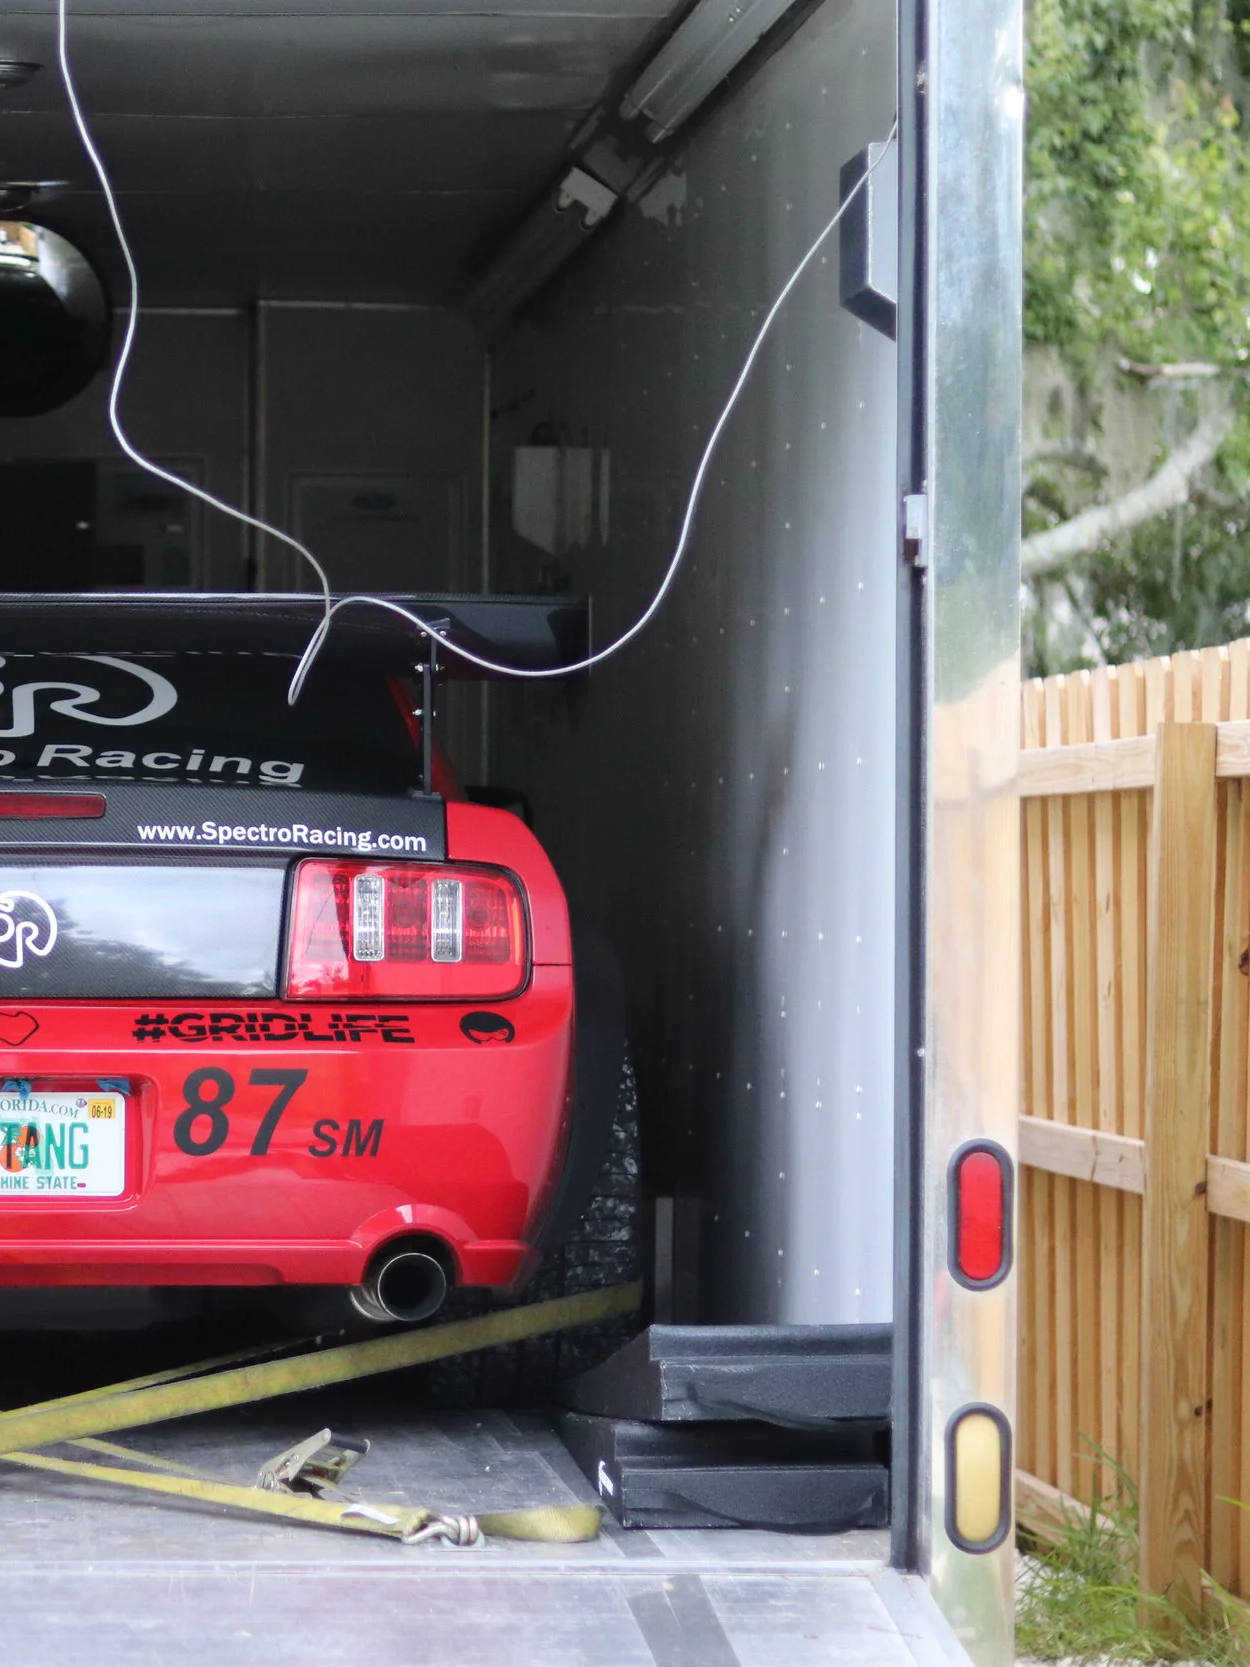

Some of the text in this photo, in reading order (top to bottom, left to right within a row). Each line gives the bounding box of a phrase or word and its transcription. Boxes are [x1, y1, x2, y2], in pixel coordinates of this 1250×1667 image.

[36, 743, 306, 785] Racing
[137, 821, 427, 851] www.SpectroRacing.com
[132, 1012, 415, 1044] #GRIDLIFE
[91, 1105, 113, 1118] 06-19
[173, 1067, 384, 1158] 87 SM
[36, 1176, 77, 1190] STATE
